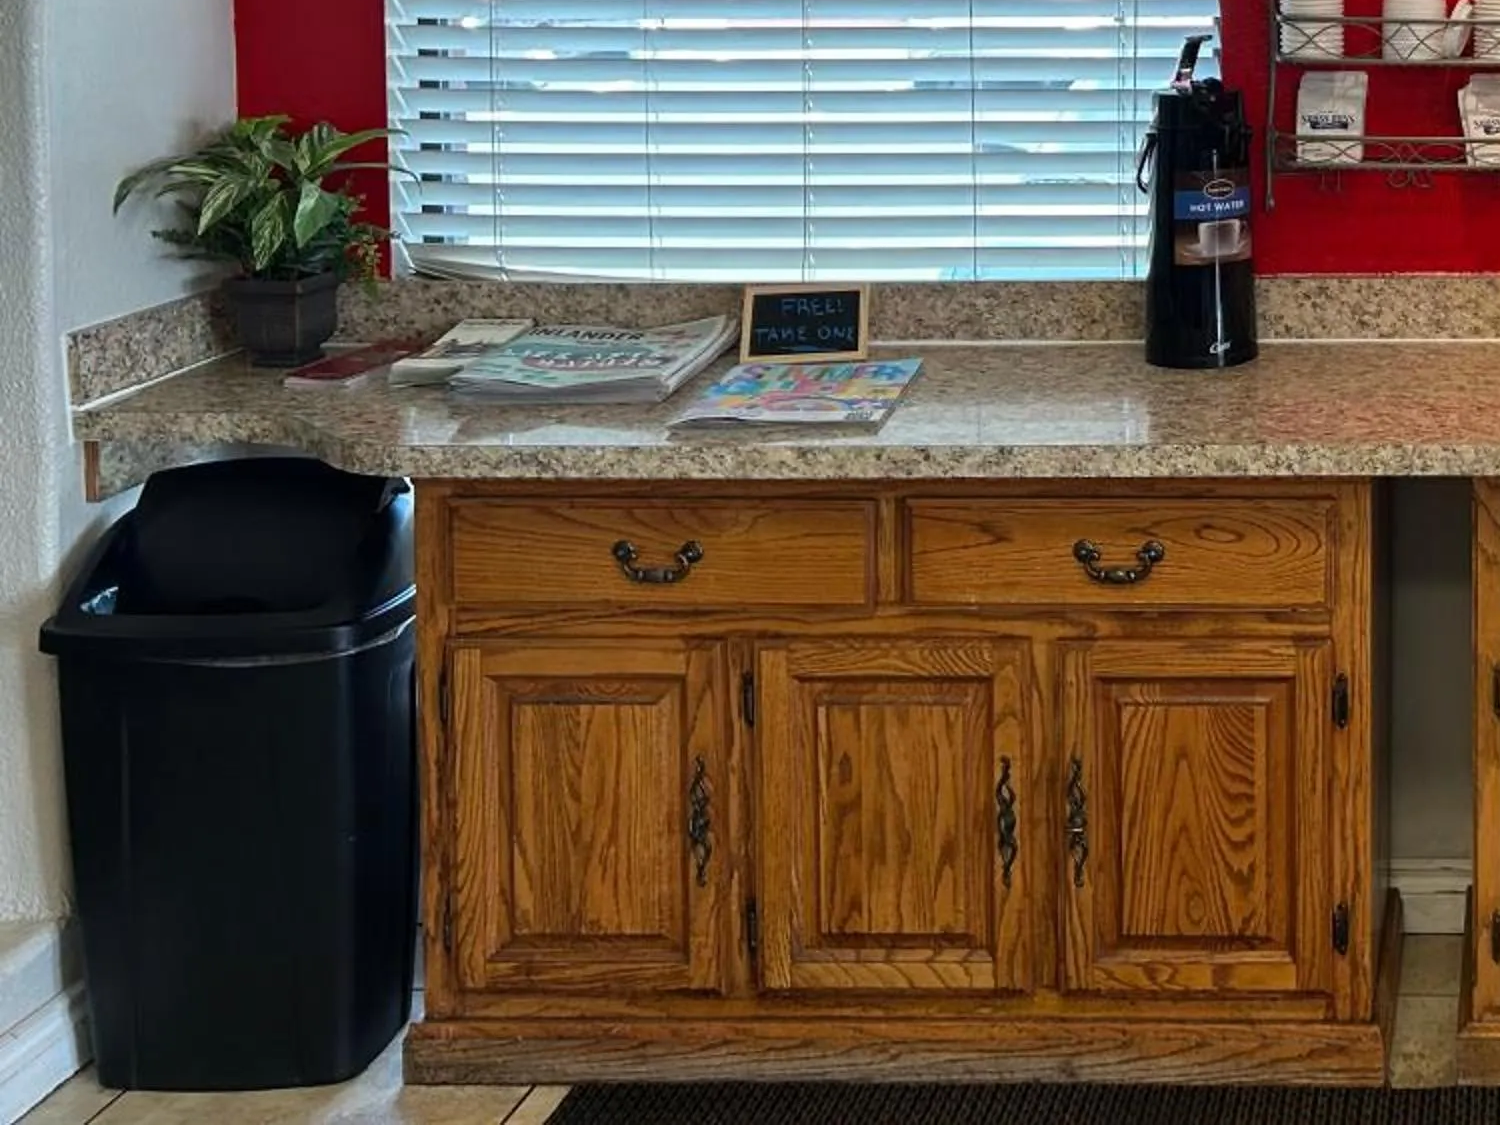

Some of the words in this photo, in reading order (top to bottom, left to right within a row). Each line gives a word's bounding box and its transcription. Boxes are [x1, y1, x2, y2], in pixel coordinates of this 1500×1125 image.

[1189, 202, 1212, 212] HOT
[1213, 199, 1244, 211] WATER
[781, 297, 844, 316] FREE!
[528, 328, 645, 341] INLANDER
[755, 325, 808, 347] TAKE
[817, 325, 856, 343] ONE
